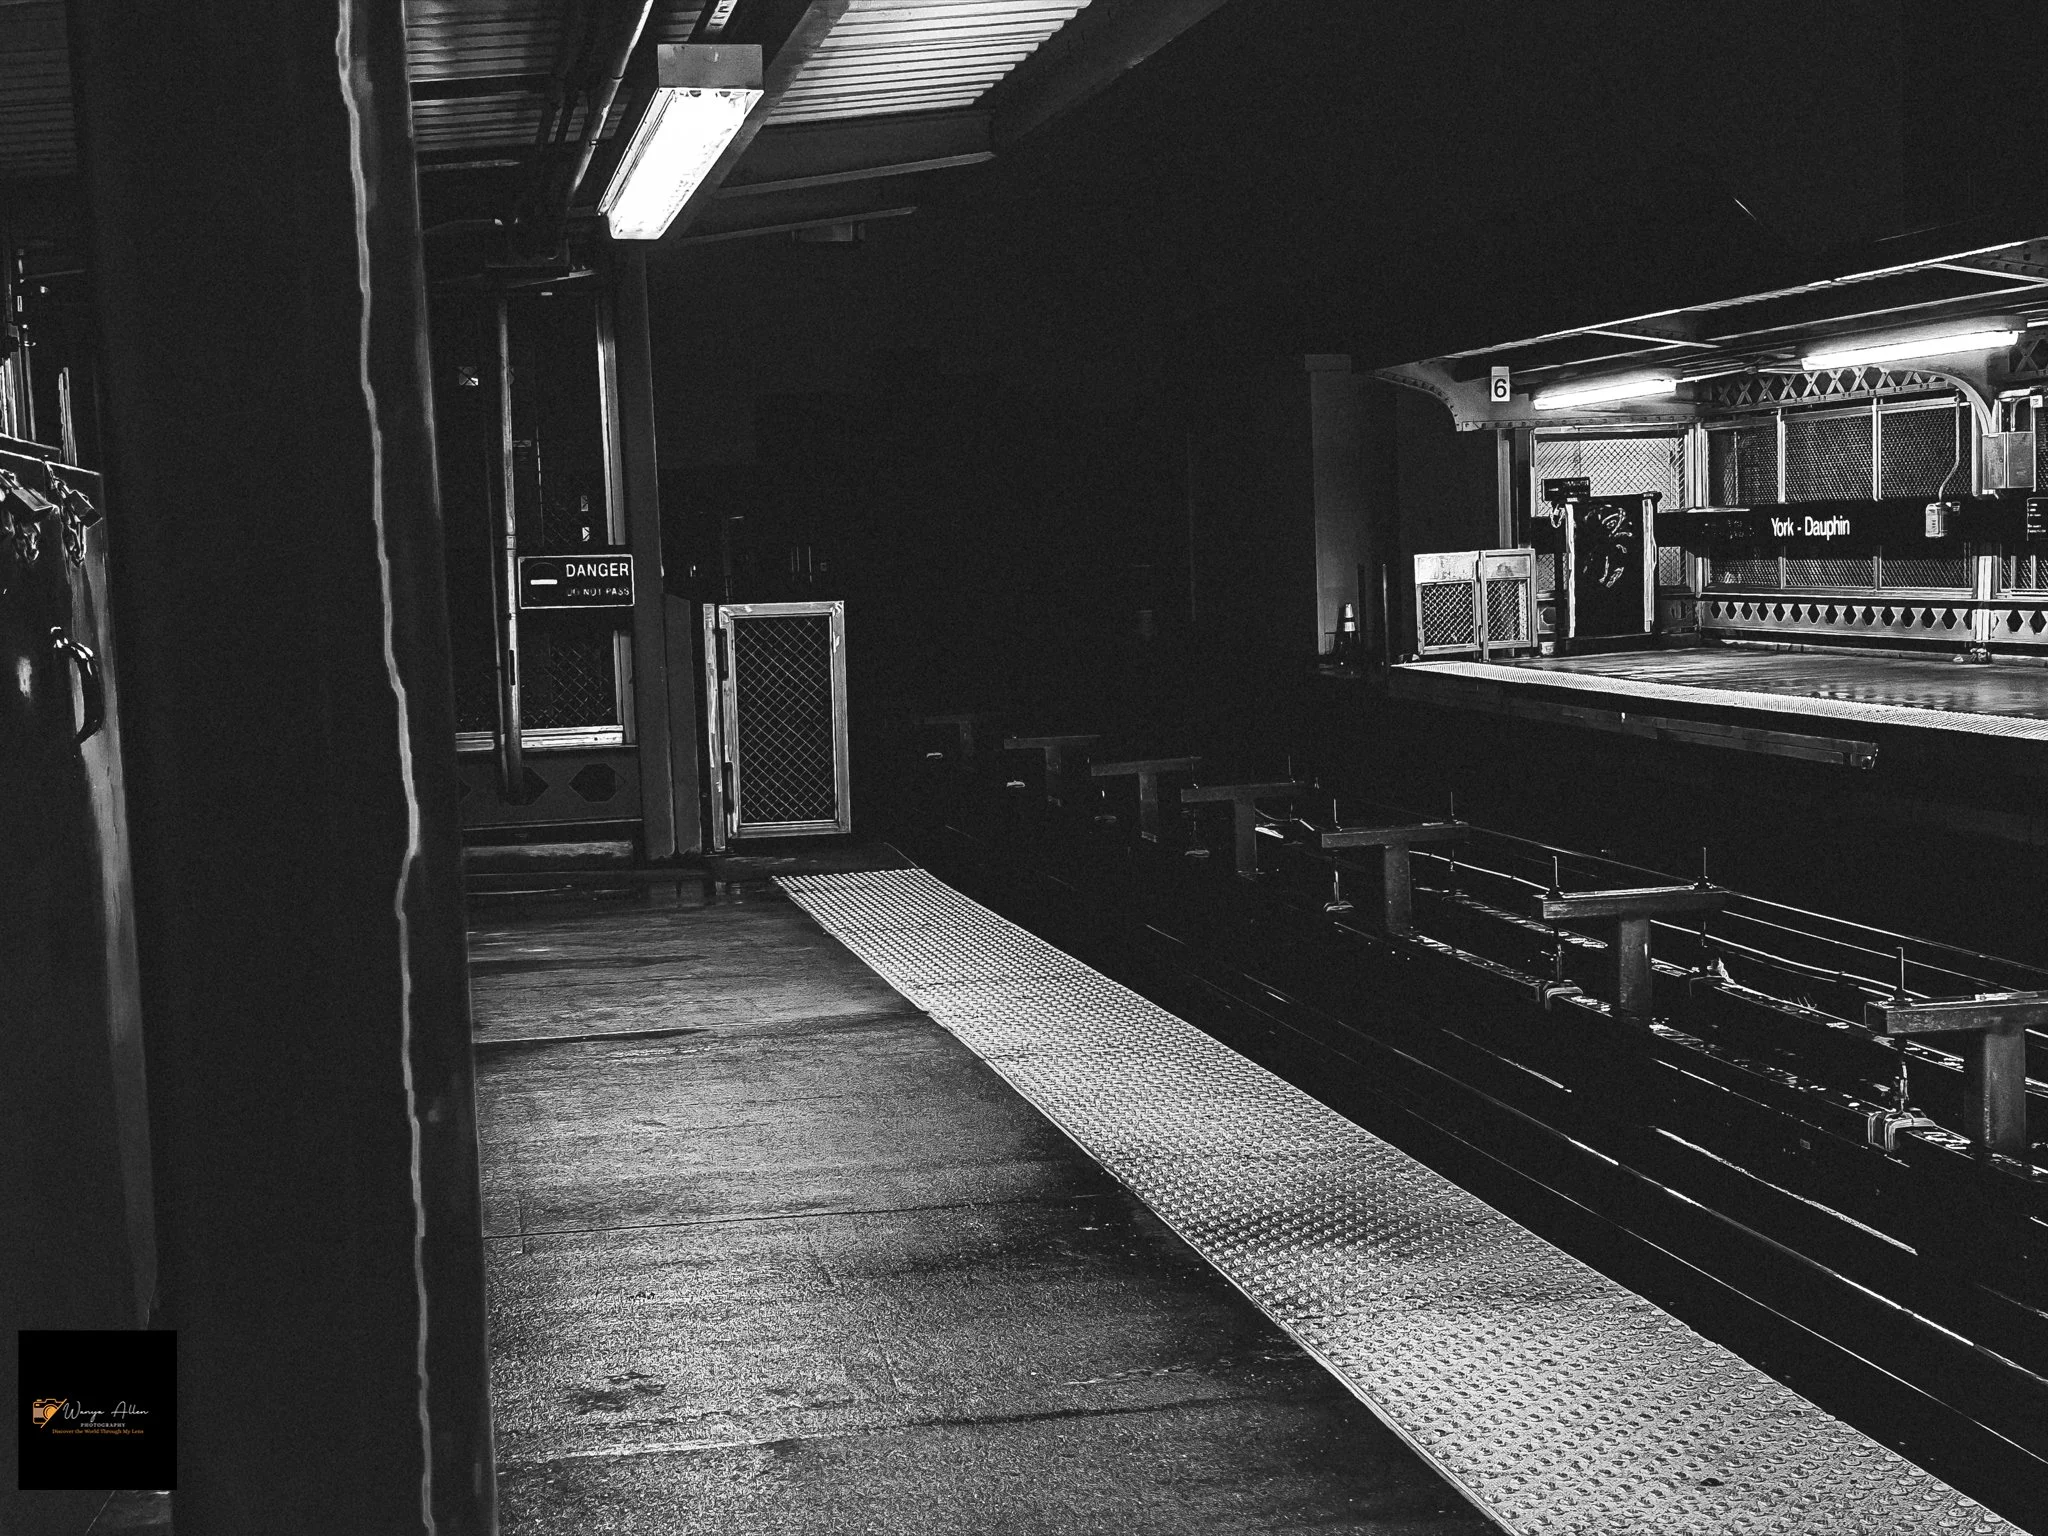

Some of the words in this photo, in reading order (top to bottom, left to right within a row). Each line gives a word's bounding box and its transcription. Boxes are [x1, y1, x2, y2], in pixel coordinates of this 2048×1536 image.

[1494, 378, 1507, 398] 6
[1770, 516, 1794, 537] York
[1804, 514, 1850, 541] Dauphin
[565, 562, 629, 577] DANGER
[583, 587, 602, 597] NOT
[605, 586, 630, 596] PASS
